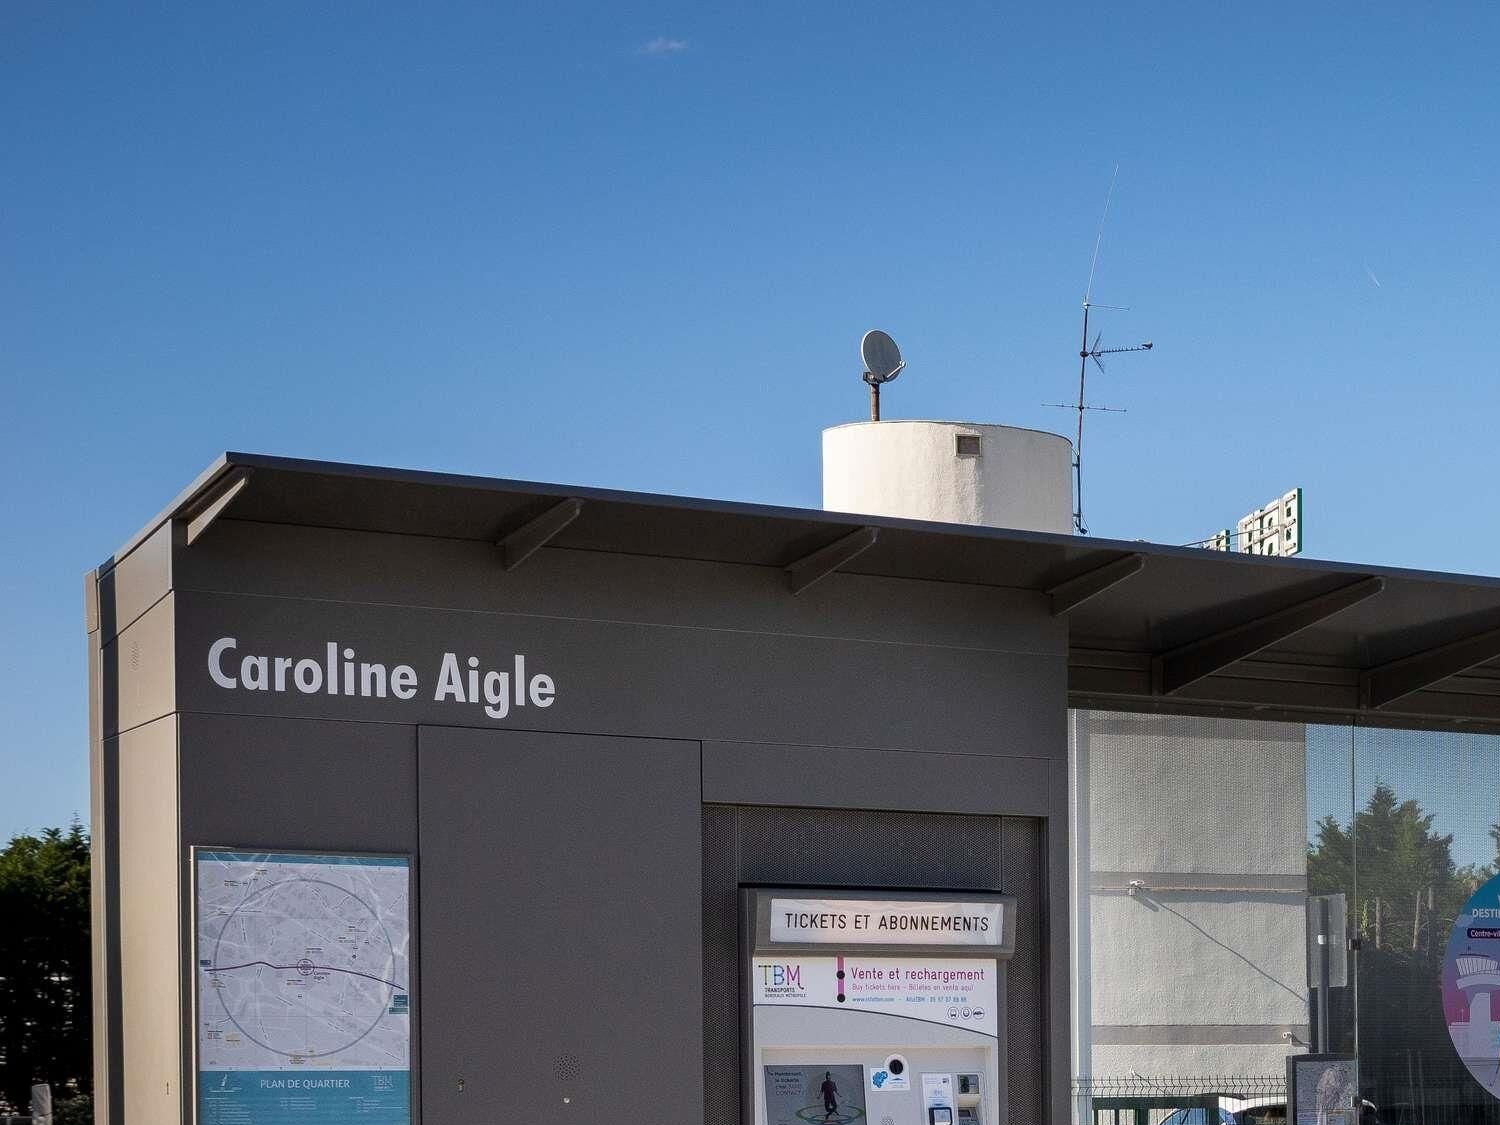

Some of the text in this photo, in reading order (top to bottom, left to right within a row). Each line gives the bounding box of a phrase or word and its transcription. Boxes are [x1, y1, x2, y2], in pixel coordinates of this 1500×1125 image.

[207, 637, 556, 719] Caroline Aigle
[785, 913, 989, 932] TICKETS ET ABONNEMENTS
[758, 965, 805, 990] TBM
[851, 967, 985, 983] Vente et rechargement
[260, 1079, 351, 1090] PLAN DE QUARTIER
